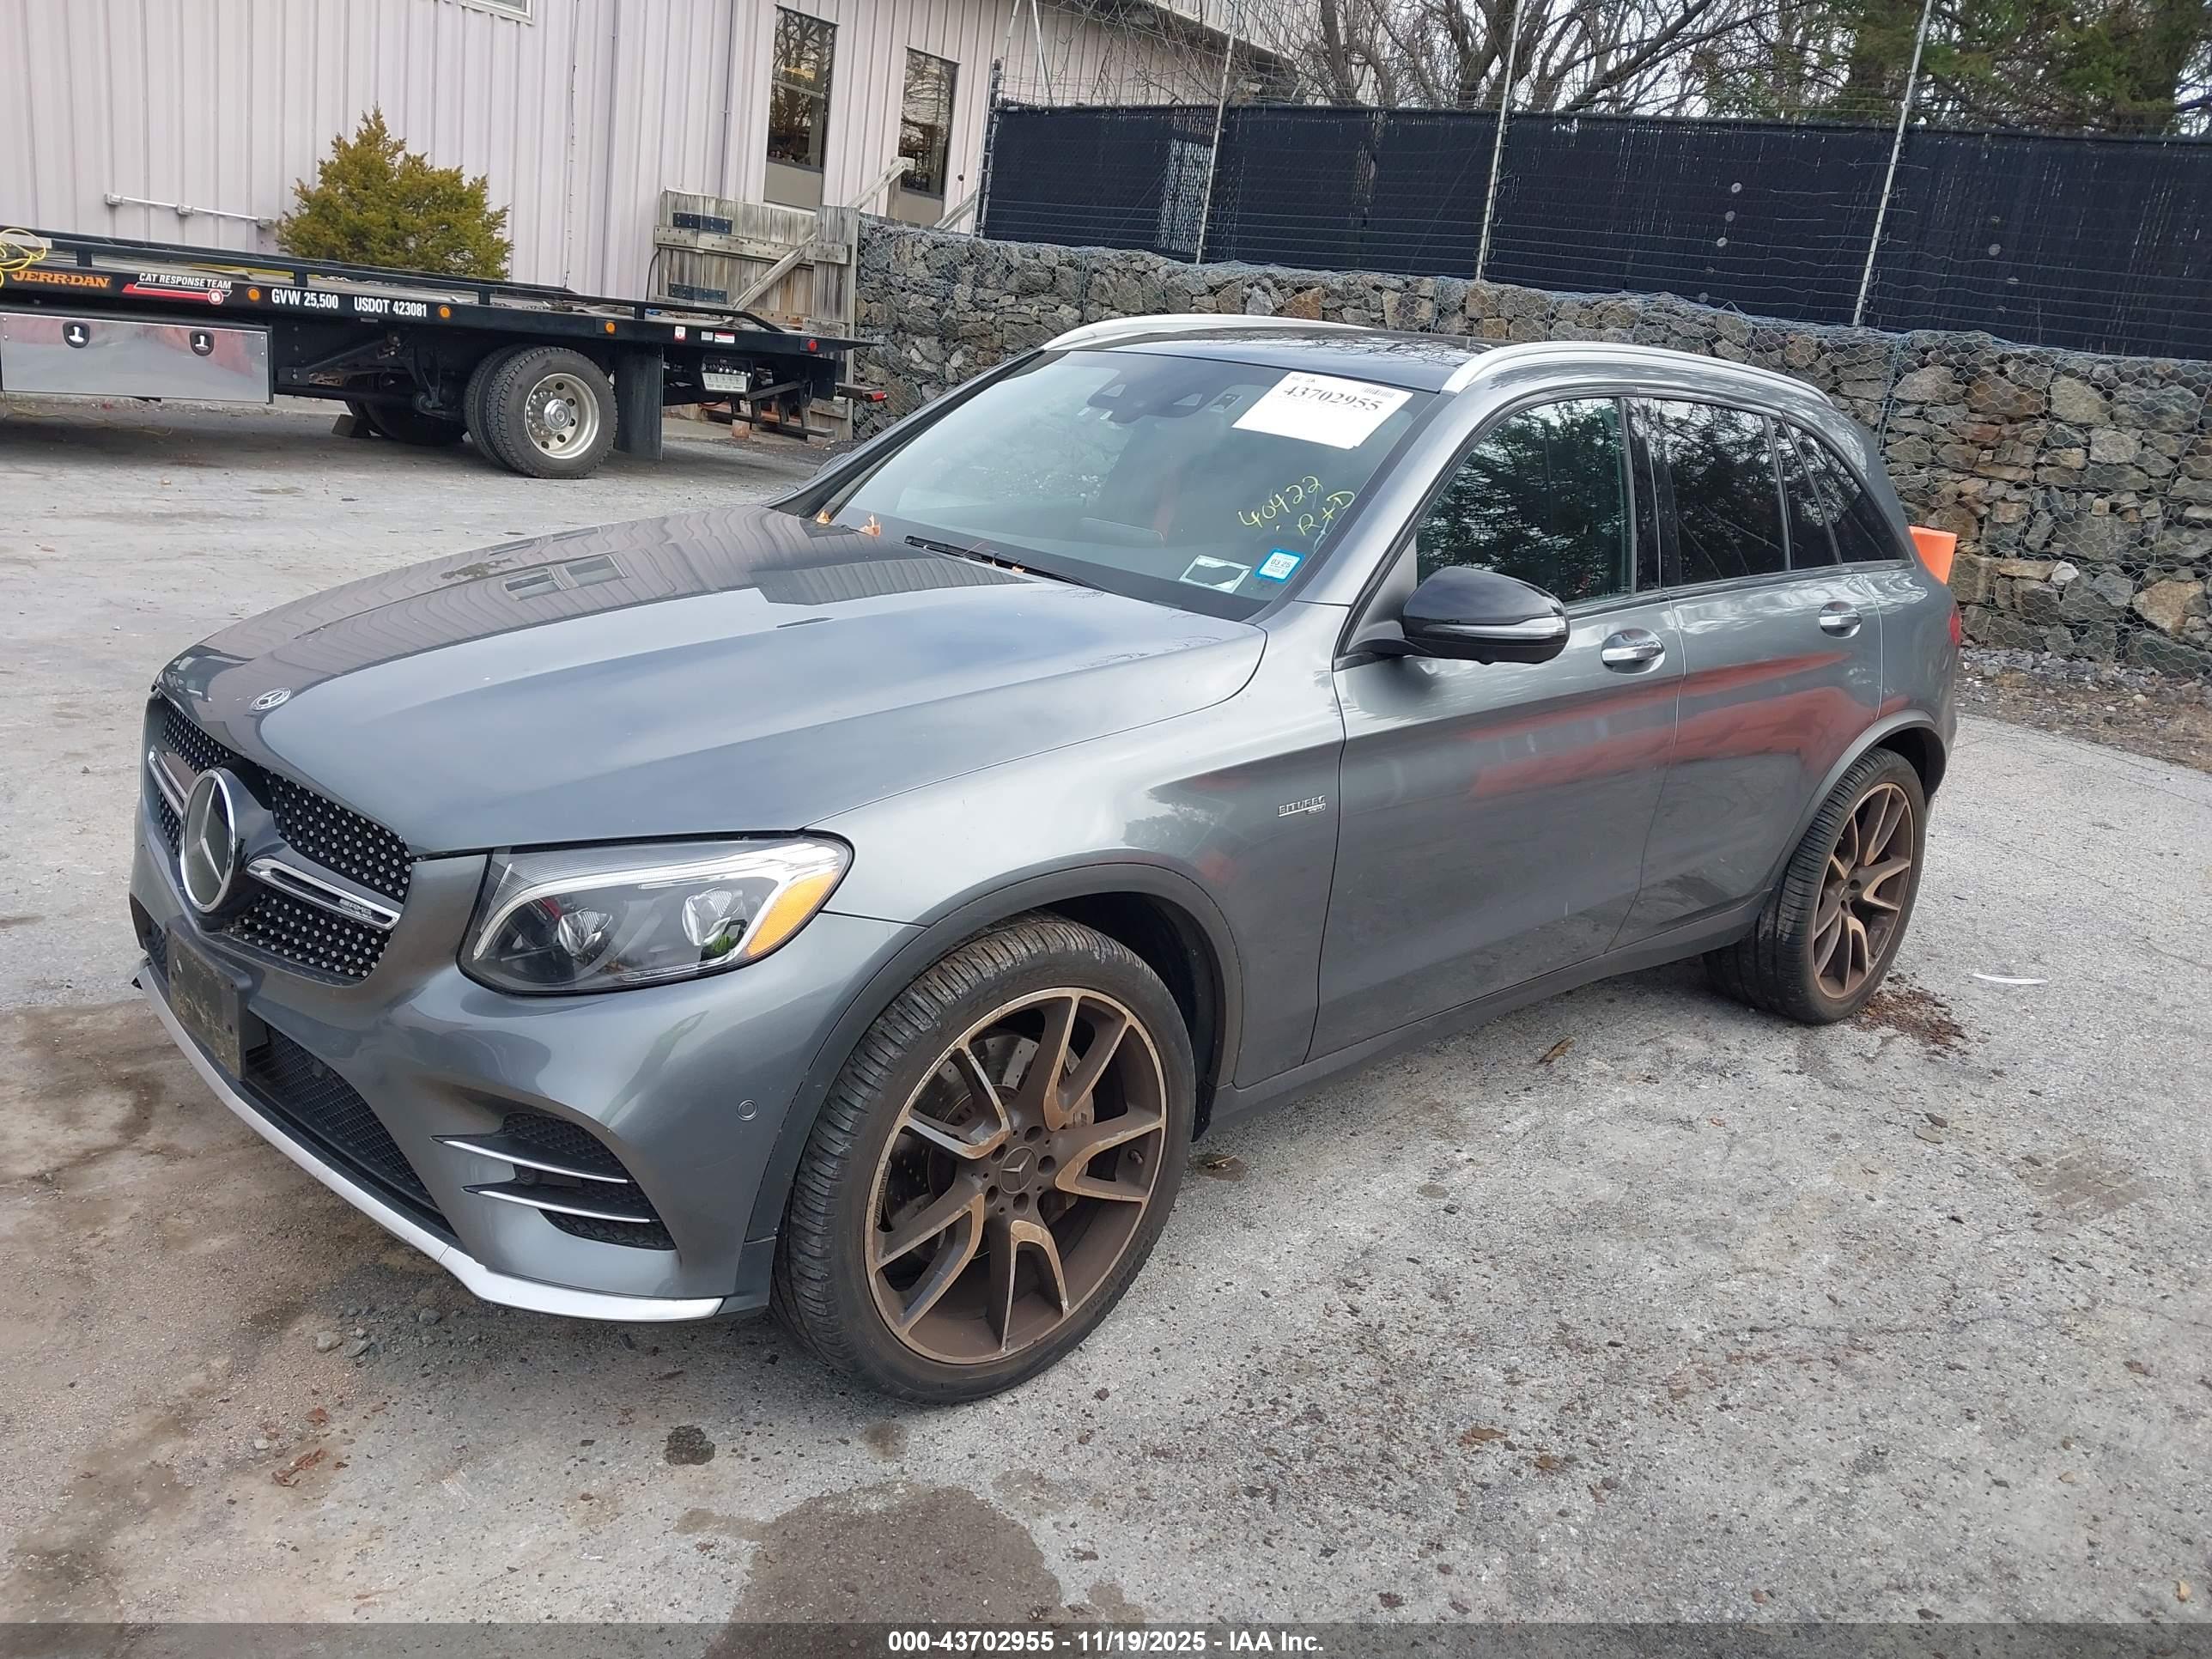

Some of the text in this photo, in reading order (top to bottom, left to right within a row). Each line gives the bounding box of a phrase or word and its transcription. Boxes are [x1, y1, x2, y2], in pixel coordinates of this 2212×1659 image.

[139, 272, 232, 289] CAT RESPONSE TEAM
[271, 289, 338, 309] GVW 25,500
[354, 296, 427, 317] USDOT 423081
[1283, 385, 1383, 411] 43702955
[1237, 476, 1323, 528] 40422
